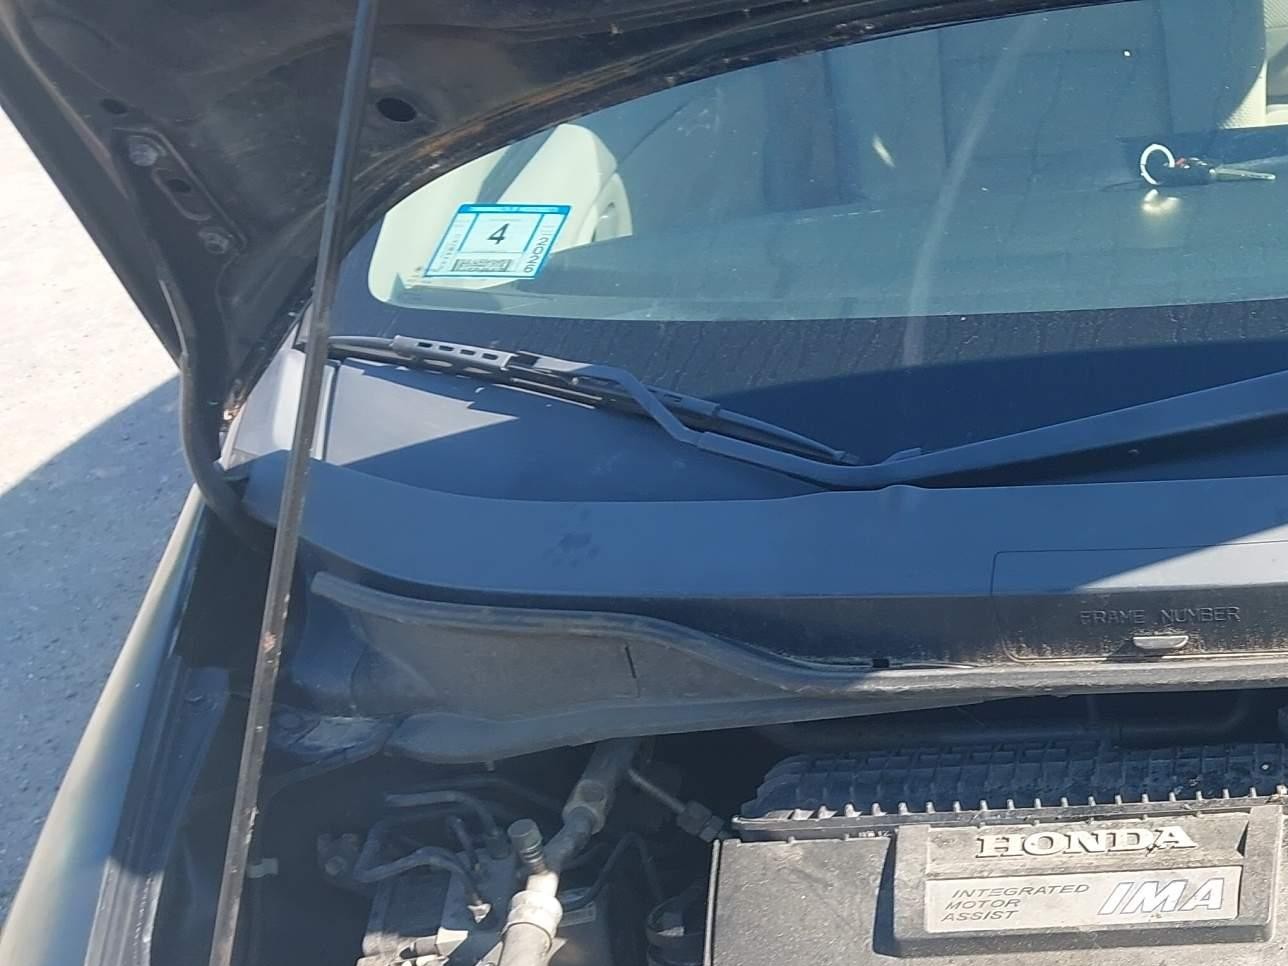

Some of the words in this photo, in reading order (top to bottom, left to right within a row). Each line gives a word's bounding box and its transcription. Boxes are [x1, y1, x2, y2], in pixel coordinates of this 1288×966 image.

[487, 223, 510, 245] 4
[523, 237, 549, 273] 2026
[1079, 609, 1145, 624] FRAME
[1160, 606, 1241, 624] NUMBER
[976, 825, 1198, 858] HONDA
[951, 884, 1090, 898] INTEGRATED
[1097, 877, 1225, 916] IMA
[945, 898, 1021, 911] MOTOR
[941, 910, 1019, 922] ASSIST
